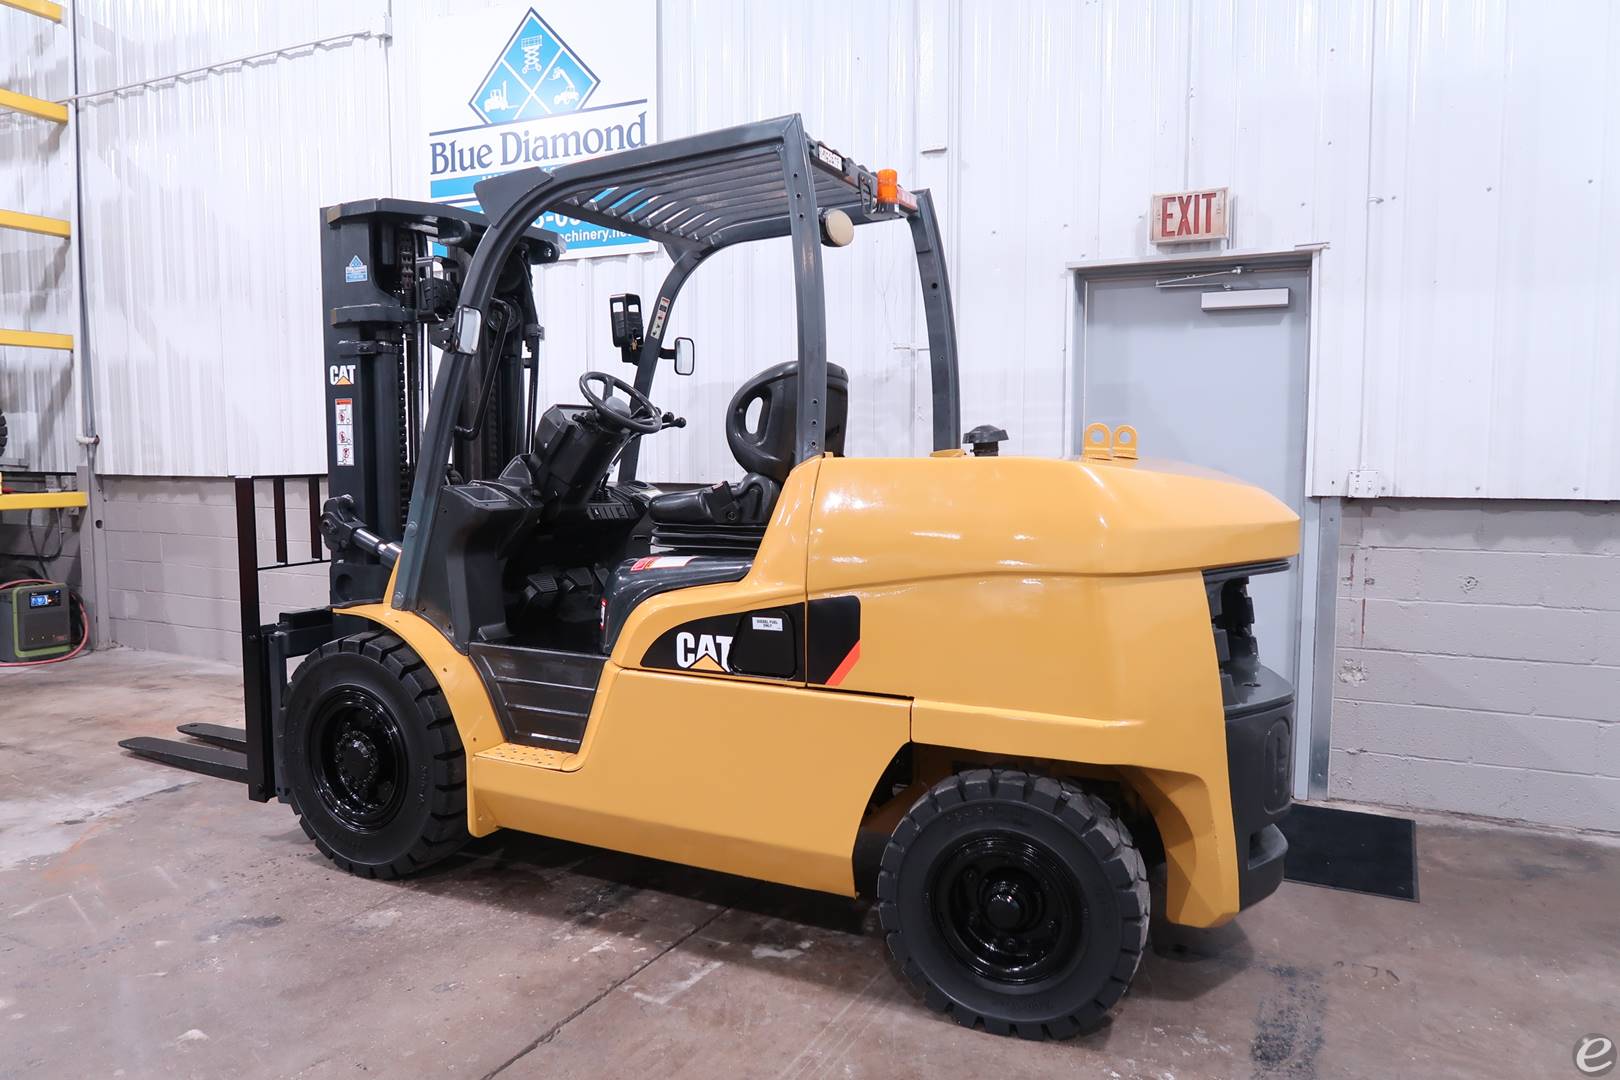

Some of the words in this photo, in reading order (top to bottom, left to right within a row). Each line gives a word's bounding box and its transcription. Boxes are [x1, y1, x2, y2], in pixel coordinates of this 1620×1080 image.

[430, 140, 493, 175] Blue
[500, 111, 647, 166] Diamond
[1161, 192, 1217, 238] EXIT
[329, 365, 356, 386] CAT
[676, 631, 733, 673] CAT
